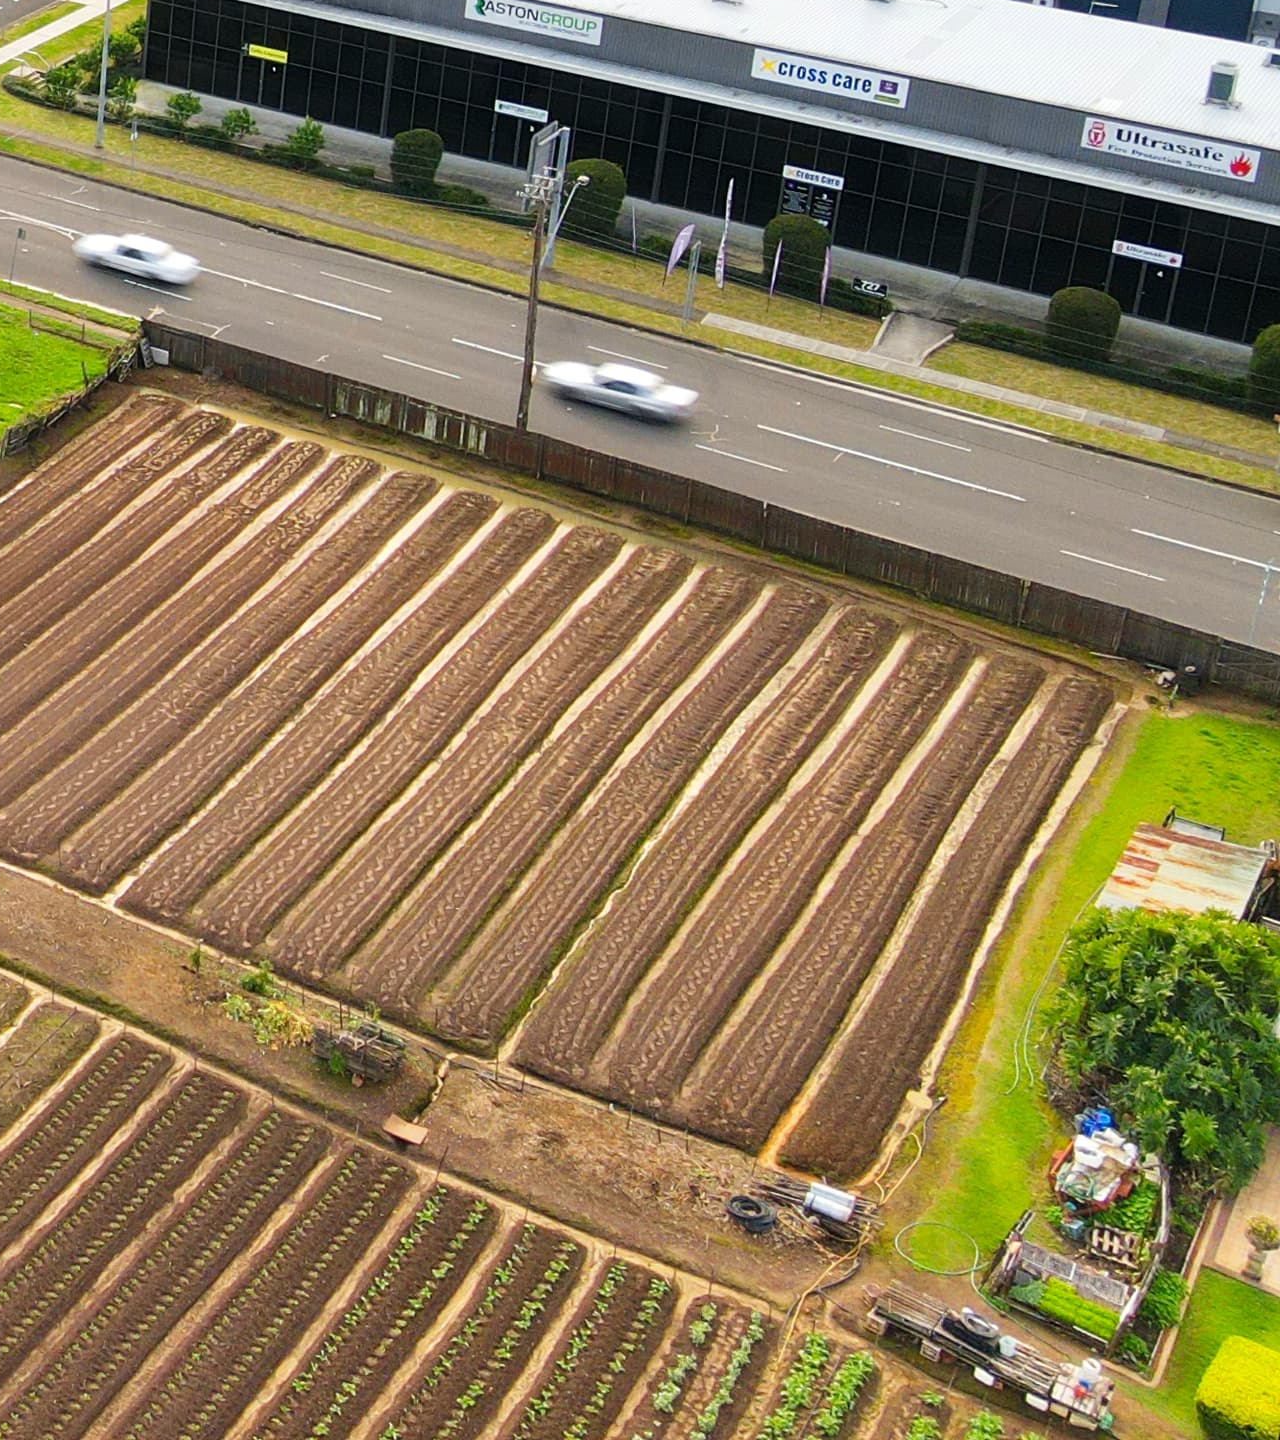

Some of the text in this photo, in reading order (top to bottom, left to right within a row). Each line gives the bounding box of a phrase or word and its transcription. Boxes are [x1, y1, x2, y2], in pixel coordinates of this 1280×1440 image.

[778, 61, 873, 93] cross care
[1115, 128, 1224, 162] Ultrasafe
